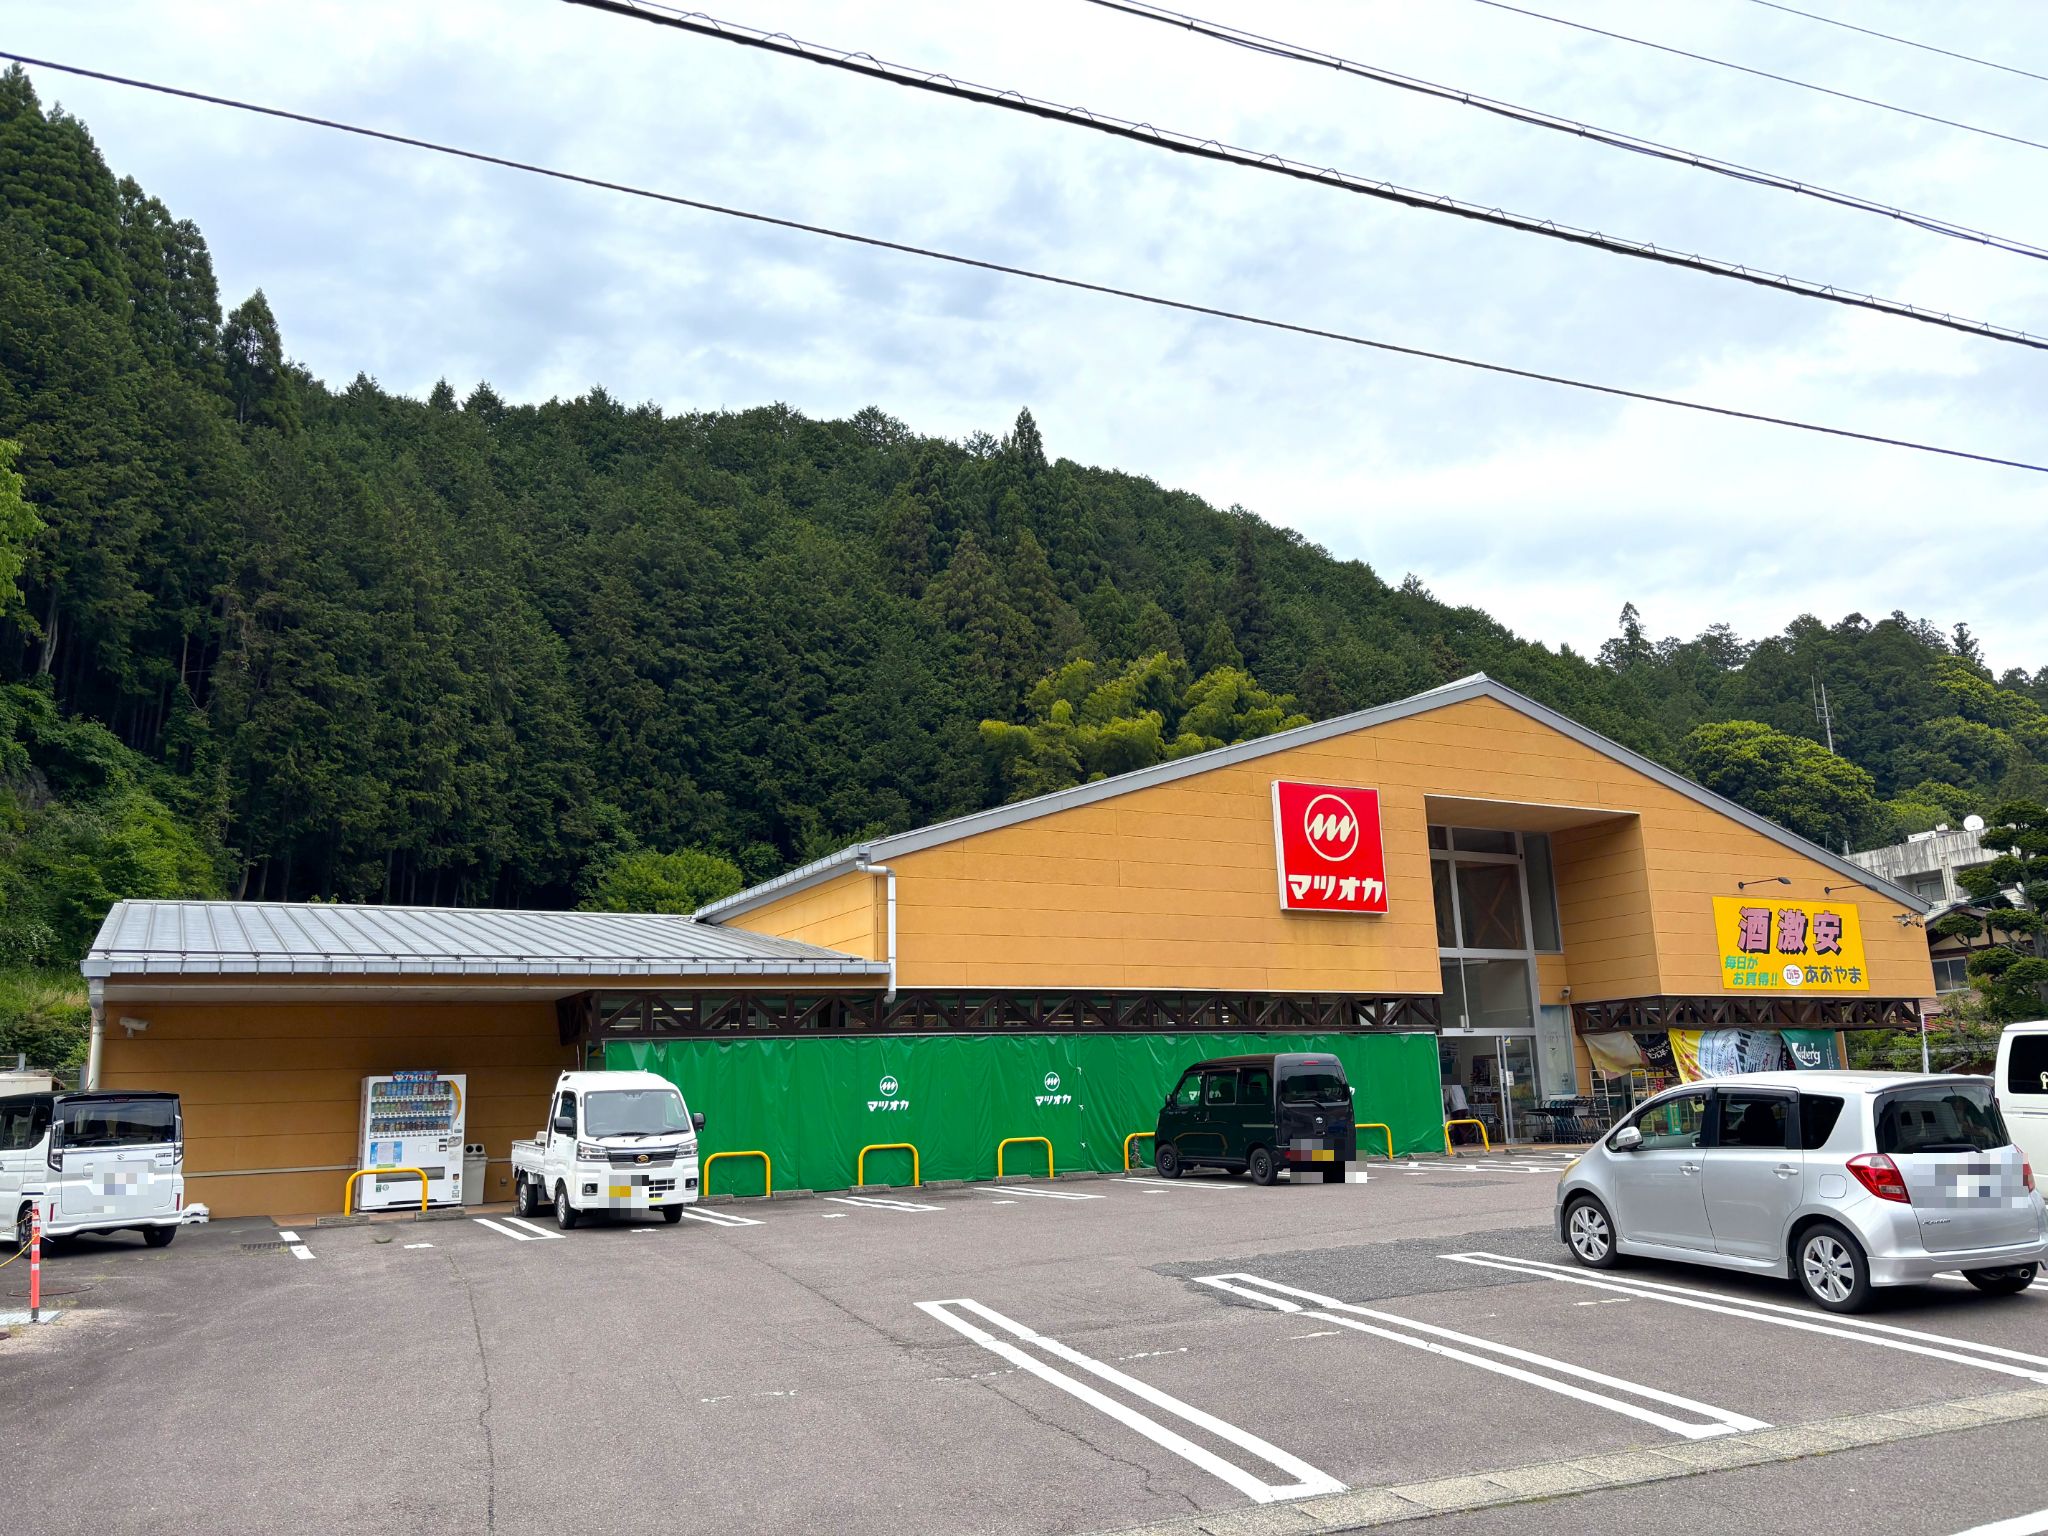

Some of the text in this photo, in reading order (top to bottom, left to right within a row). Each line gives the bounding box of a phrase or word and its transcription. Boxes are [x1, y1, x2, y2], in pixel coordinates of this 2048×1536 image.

[1288, 874, 1383, 904] マツオカ
[1736, 905, 1843, 956] 酒激安
[1725, 955, 1758, 970] 毎日が
[1804, 965, 1862, 984] あおやま
[867, 1100, 910, 1112] マツオカ
[1034, 1094, 1072, 1106] マツオカ
